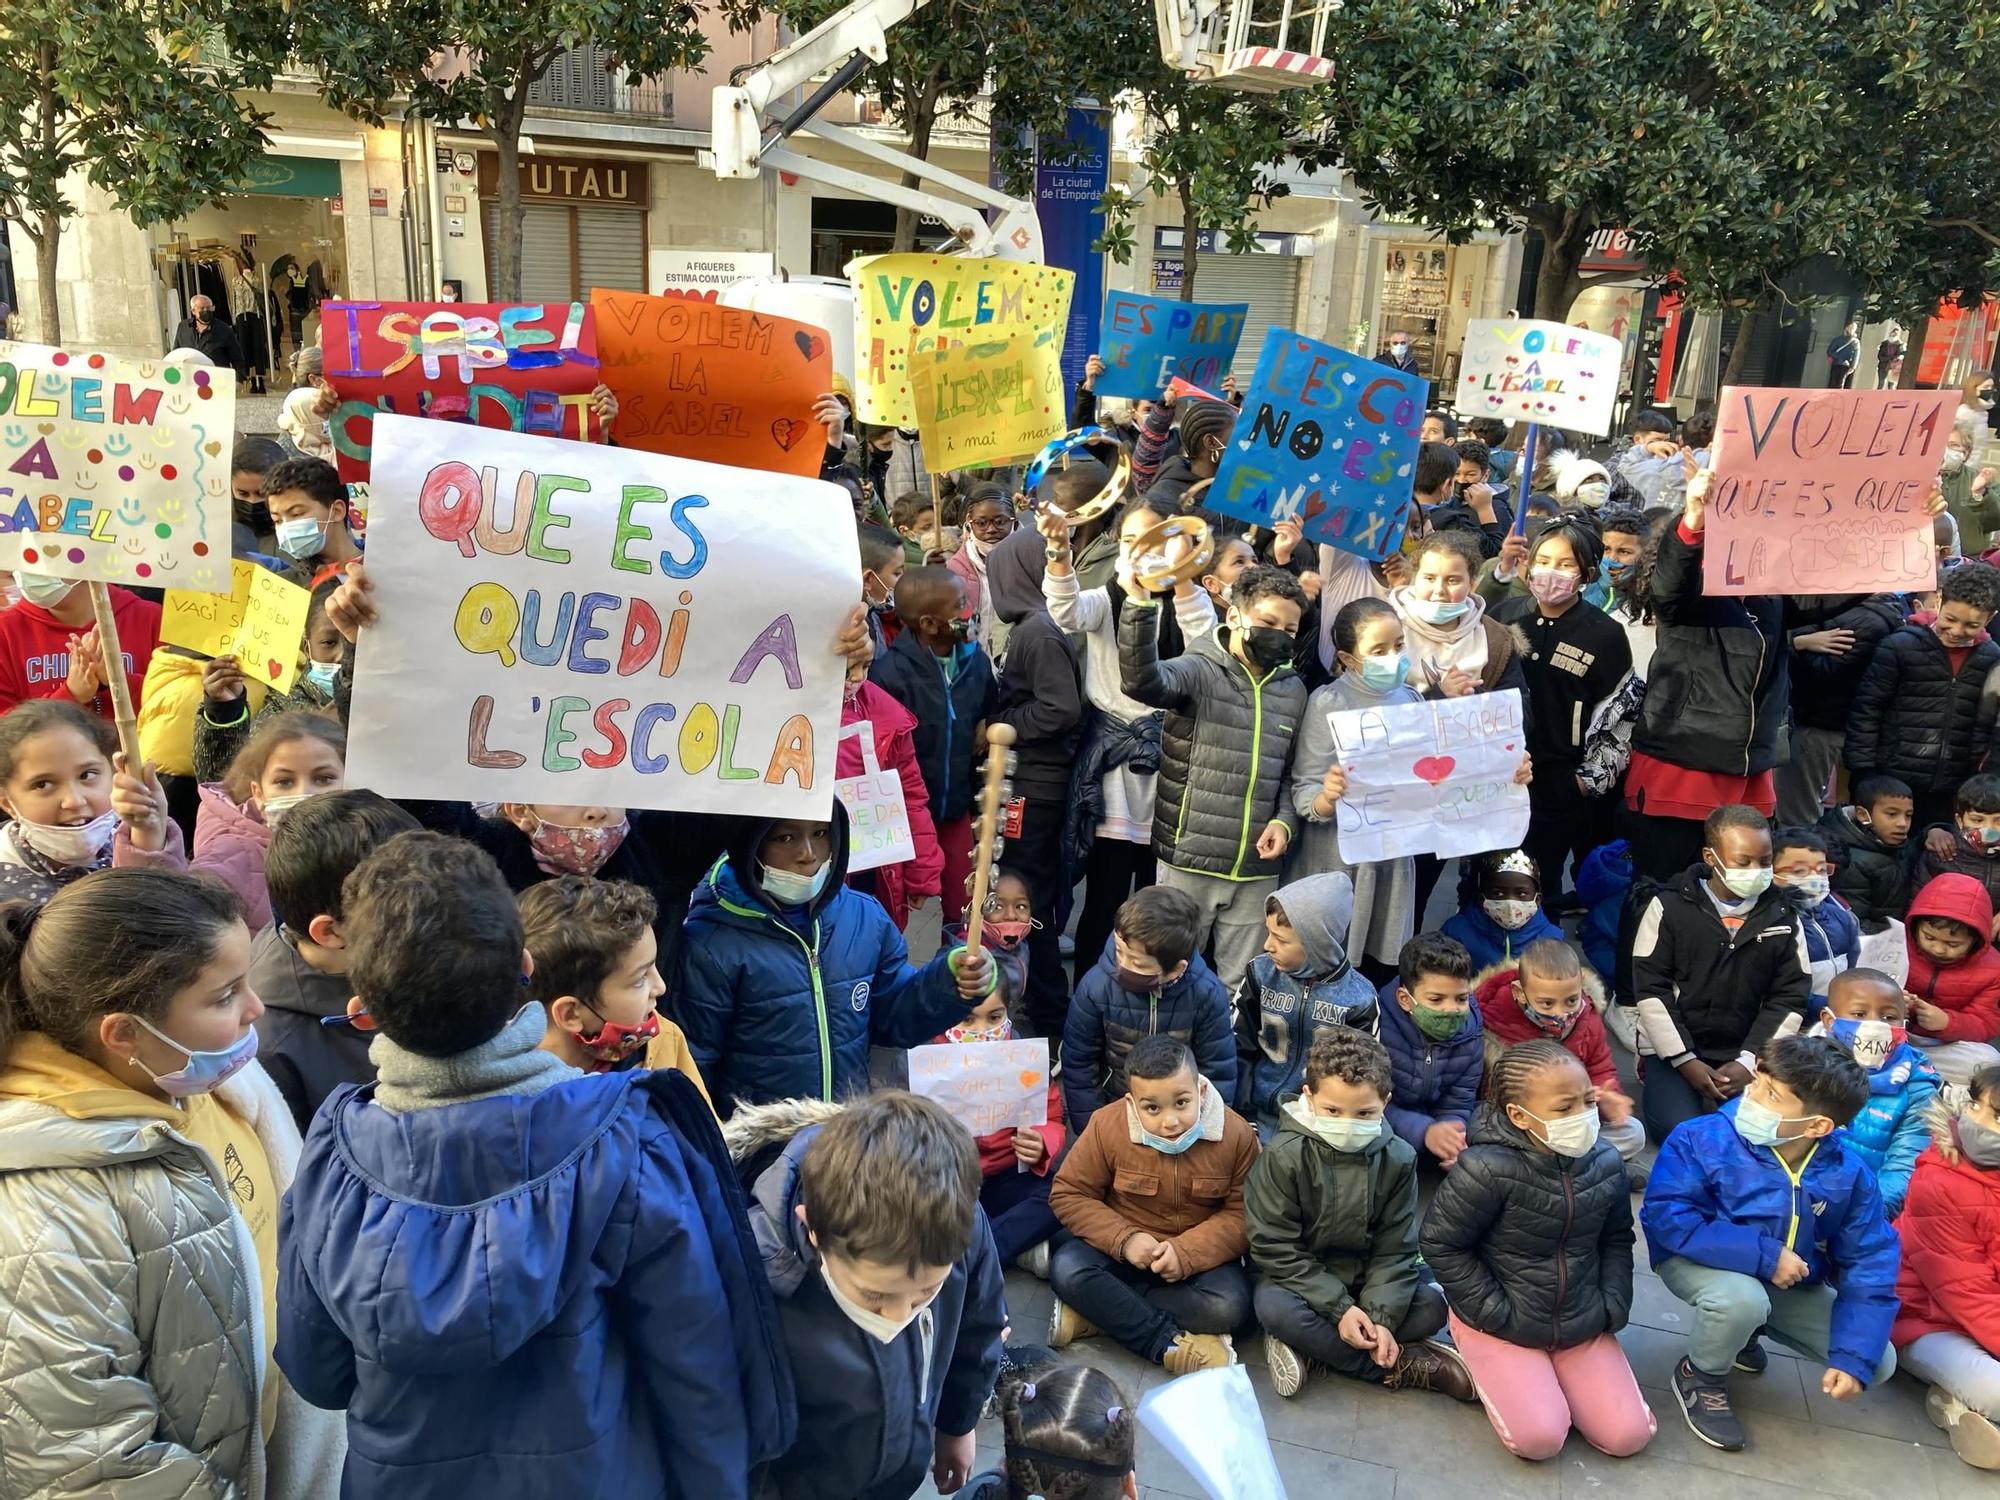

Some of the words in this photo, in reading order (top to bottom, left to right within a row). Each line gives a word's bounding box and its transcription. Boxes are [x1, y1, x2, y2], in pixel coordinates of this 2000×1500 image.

[518, 163, 628, 198] UTAU
[1041, 188, 1053, 199] de
[1052, 176, 1064, 187] La
[1066, 177, 1092, 188] ciutat
[665, 273, 698, 284] ESTIMA
[699, 274, 720, 284] COM
[687, 262, 693, 271] A
[694, 262, 736, 272] FIGUERES
[877, 275, 1025, 330] VOLEM
[1112, 301, 1158, 335] ES
[1166, 308, 1243, 347] PART
[325, 302, 600, 384] ISABEL
[606, 297, 775, 355] VOLEM
[1491, 326, 1603, 357] VOLEM
[668, 352, 708, 395] LA
[869, 337, 886, 386] A
[1525, 359, 1541, 376] A
[935, 359, 1035, 423] L'ISABEL
[8, 436, 60, 481] A
[964, 431, 997, 448] mai
[1248, 402, 1324, 461] NO
[1342, 437, 1398, 485] ES
[418, 460, 592, 564] QUE
[610, 485, 710, 580] ES
[1715, 476, 1787, 522] QUE
[1793, 480, 1836, 519] ES
[1854, 476, 1921, 514] QUE
[1725, 536, 1768, 586] LA
[1799, 537, 1922, 577] ISABEL
[261, 577, 286, 600] QUE
[252, 623, 271, 646] US
[728, 613, 804, 690] A
[467, 694, 816, 791] L'ESCOLA
[1331, 711, 1391, 753] LA
[1436, 703, 1521, 749] ISABEL
[1338, 788, 1396, 833] SE
[1438, 782, 1509, 822] QUEDA
